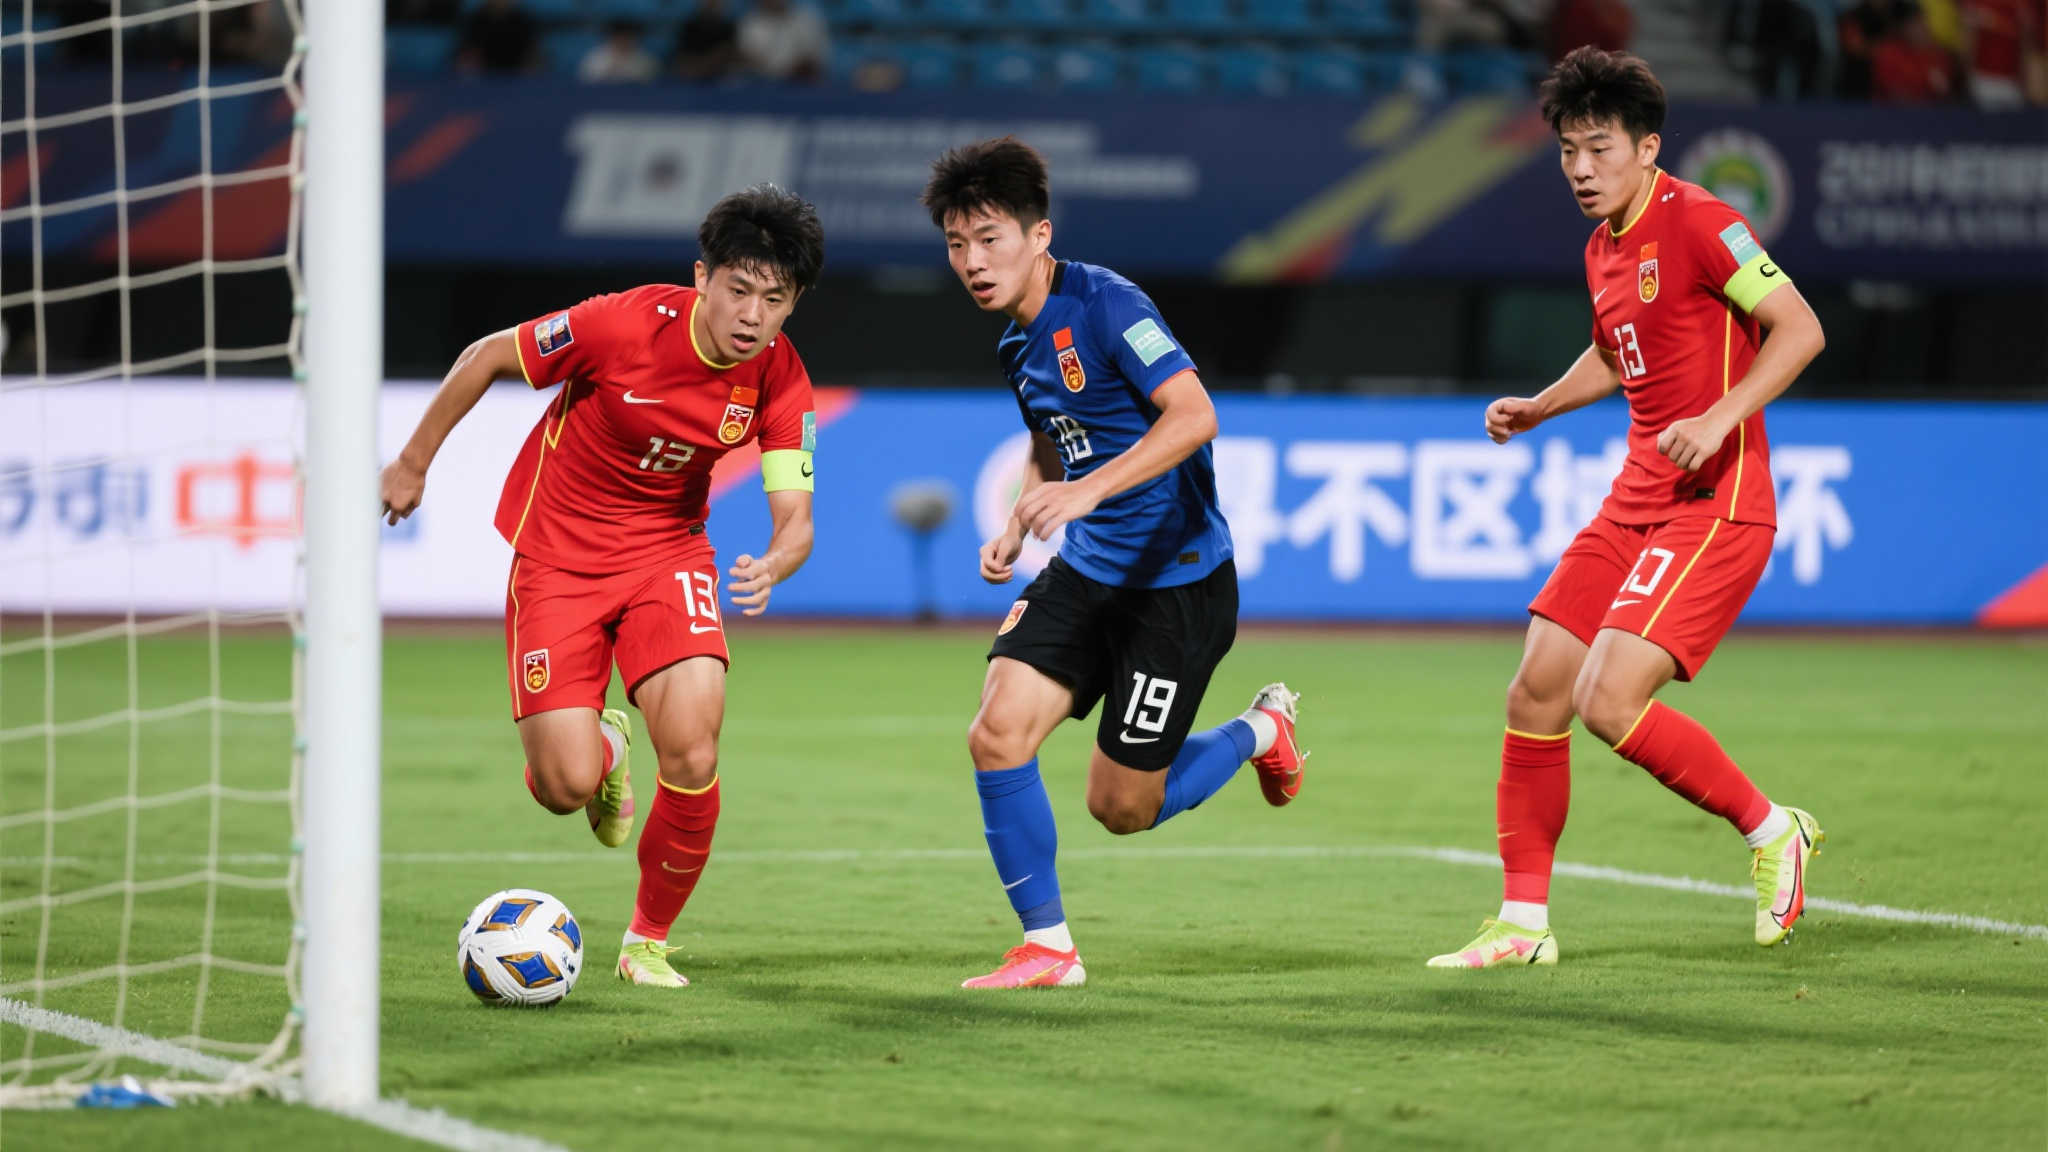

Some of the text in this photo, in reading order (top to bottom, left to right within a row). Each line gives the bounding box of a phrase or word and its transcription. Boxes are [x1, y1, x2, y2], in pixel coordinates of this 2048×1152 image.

[1614, 322, 1646, 379] 13
[675, 571, 718, 622] 13
[1123, 671, 1178, 733] 19
